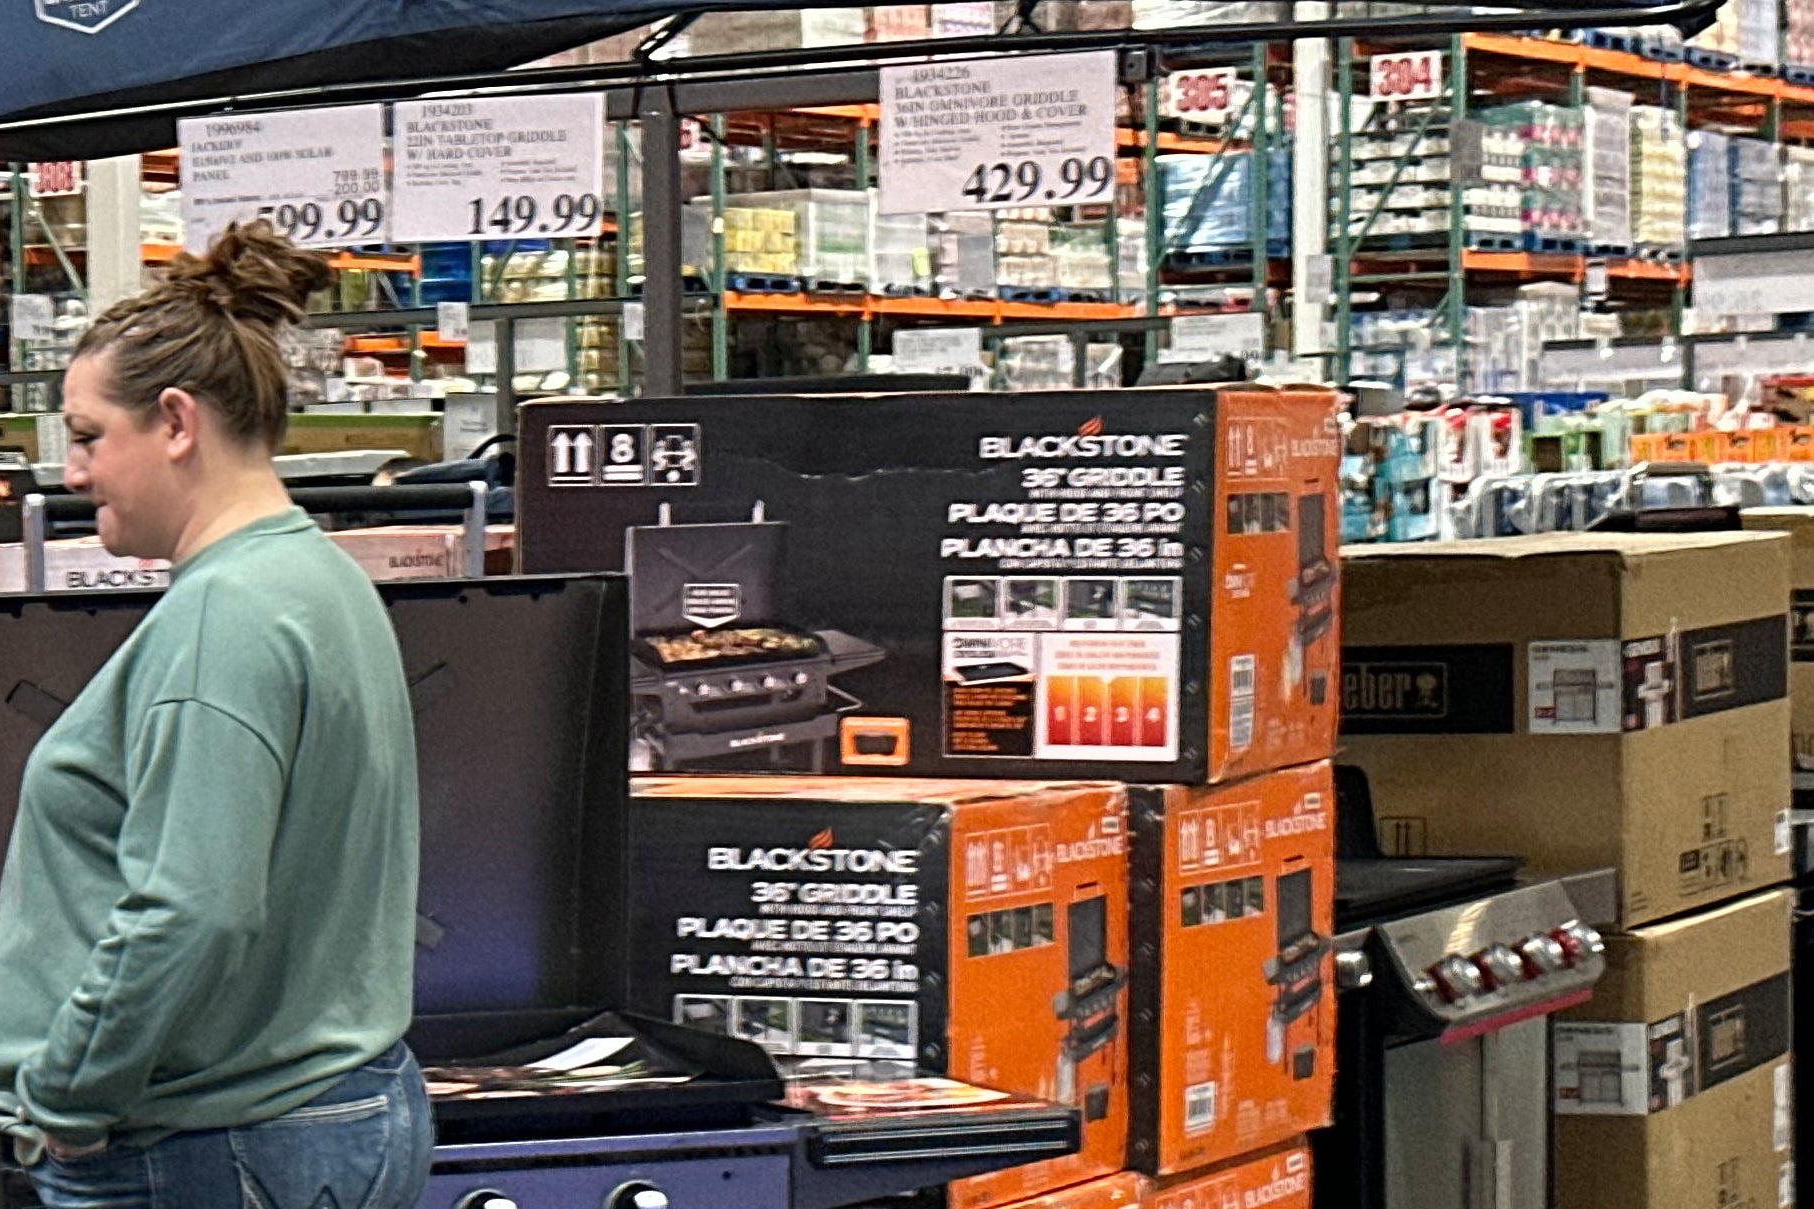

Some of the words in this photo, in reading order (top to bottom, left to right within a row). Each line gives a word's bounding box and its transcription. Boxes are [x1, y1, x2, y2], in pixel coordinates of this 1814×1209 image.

[69, 1, 108, 18] TENT
[1379, 56, 1431, 96] 304
[895, 80, 991, 99] BLACKSTONE
[929, 95, 1010, 113] OMNIVORE
[1012, 89, 1079, 105] GRIDDLE
[975, 108, 1017, 124] HOOD
[1021, 108, 1032, 120] &
[1036, 103, 1087, 119] COVER
[406, 118, 493, 133] BLACKSTONE
[191, 139, 243, 152] JACKERY
[437, 131, 504, 146] TABLETOP
[507, 129, 567, 143] GRIDDLE
[239, 152, 263, 164] AND
[295, 147, 334, 159] SOLAR
[426, 147, 464, 159] HARD
[467, 145, 512, 158] COVER
[193, 170, 230, 182] PANEL
[962, 156, 1113, 203] 429.99
[467, 193, 601, 235] 149.99
[610, 432, 636, 464] 8
[979, 434, 1189, 458] BLACKSTONE
[1068, 466, 1185, 487] GRIDDLE
[948, 503, 1057, 524] PLAQUE
[1060, 503, 1099, 521] DE
[1102, 503, 1139, 522] 36
[1144, 502, 1185, 522] PO
[940, 538, 1071, 558] PLANCHA
[1074, 538, 1114, 557] DE
[1117, 538, 1155, 557] 36
[67, 568, 171, 588] BLACKS
[1343, 664, 1412, 710] eber
[1265, 811, 1327, 839] BLACKSTONE
[707, 847, 920, 873] BLACKSTONE
[1056, 835, 1124, 863] BLACKSTONE
[799, 882, 919, 905] GRIDDLE
[676, 917, 786, 940] PLAQUE
[790, 919, 829, 940] DE
[834, 920, 873, 942] 36
[876, 921, 920, 943] PO
[671, 954, 803, 977] PLANCHA
[807, 957, 847, 978] DE
[849, 958, 889, 979] 36
[1244, 1173, 1307, 1209] BLACKSTONE
